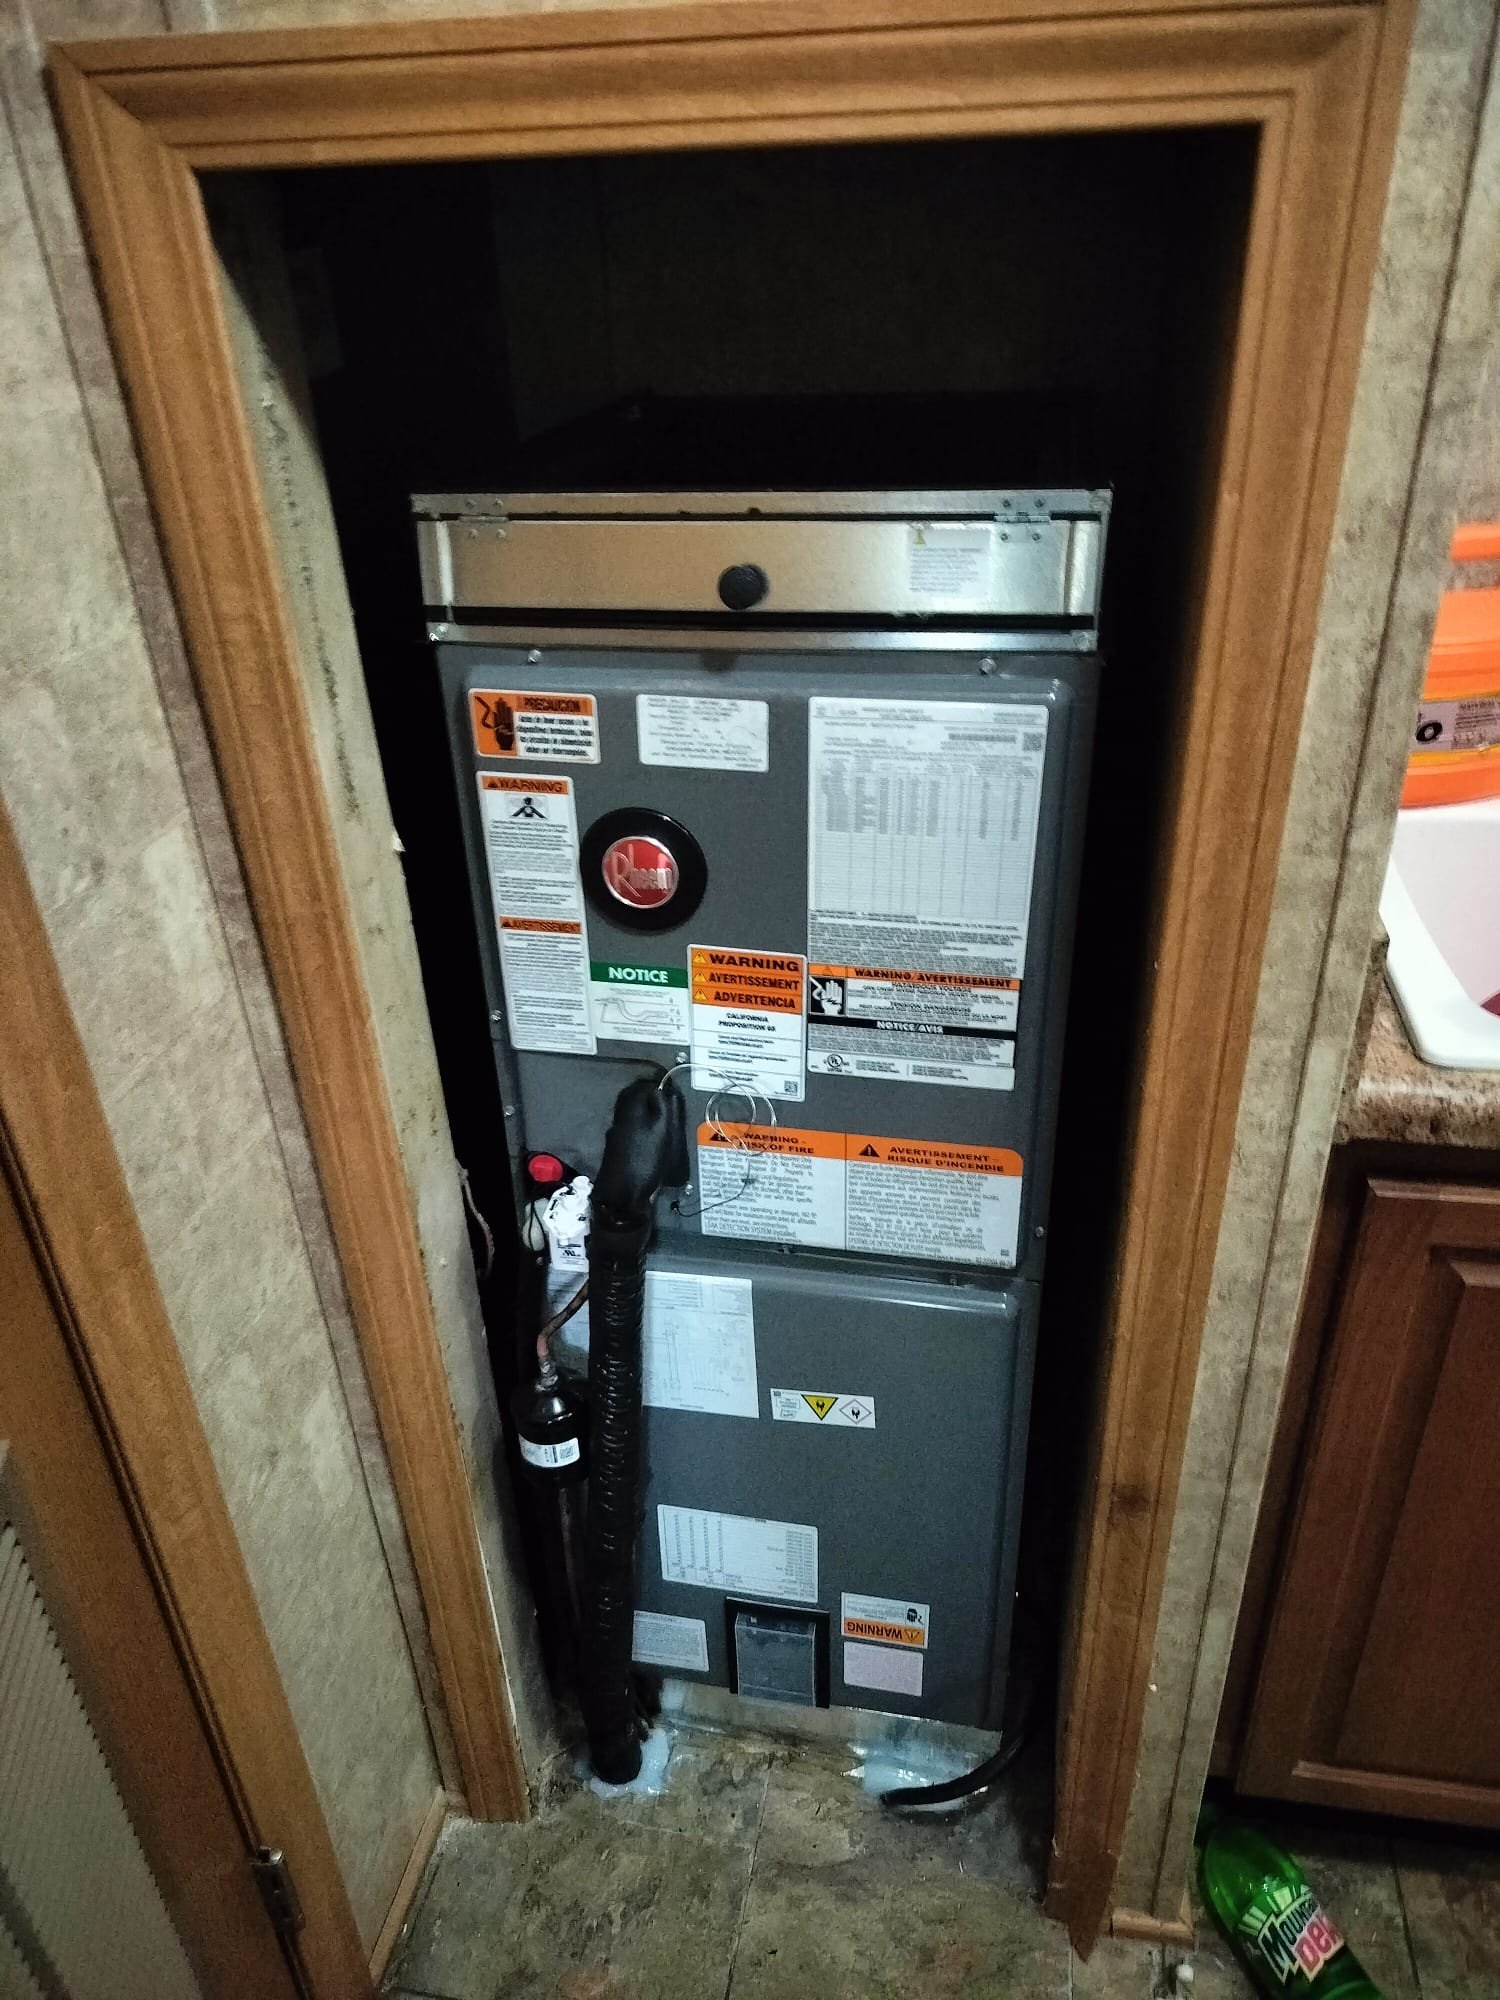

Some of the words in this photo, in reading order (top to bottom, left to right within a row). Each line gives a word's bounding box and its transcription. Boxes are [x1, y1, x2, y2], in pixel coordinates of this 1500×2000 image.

[500, 778, 563, 793] WARNING
[709, 953, 799, 972] WARNING
[608, 966, 669, 984] NOTICE
[709, 972, 799, 990] AVERTISSEMENT
[714, 991, 796, 1009] ADVERTENCIA
[719, 1020, 766, 1031] PROPOSITION
[726, 1013, 769, 1022] CALIFORNIA
[744, 1132, 799, 1144] WARNING
[769, 1143, 783, 1151] OF
[788, 1146, 815, 1154] FIRE
[889, 1146, 990, 1162] AVERTISSEMENT
[887, 1155, 933, 1165] RISQUE
[935, 1160, 1005, 1173] D'INCENDIE
[847, 1621, 903, 1640] WARNING
